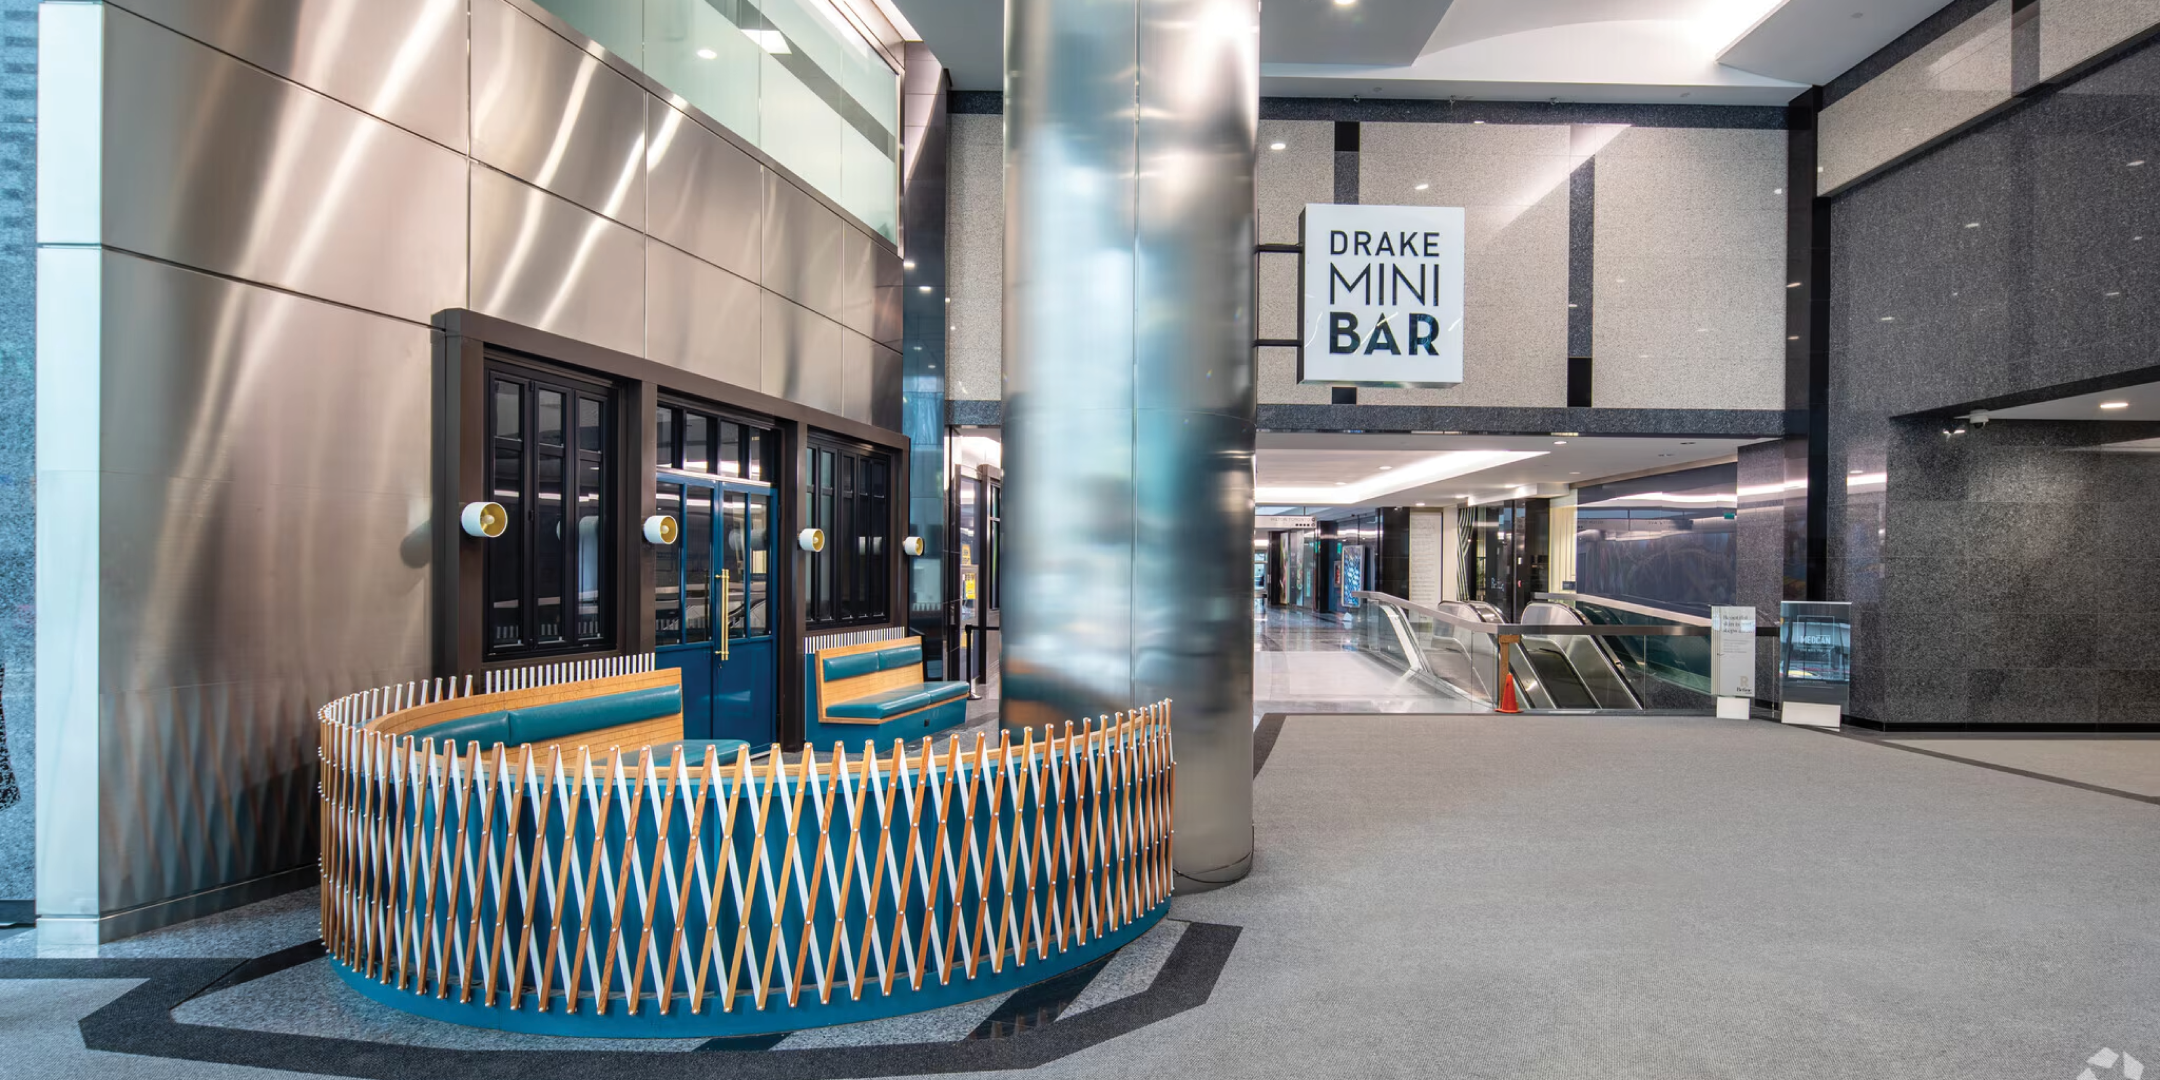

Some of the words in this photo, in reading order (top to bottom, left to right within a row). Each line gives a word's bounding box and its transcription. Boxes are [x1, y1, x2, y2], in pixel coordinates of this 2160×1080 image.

[1330, 230, 1440, 257] DRAKE
[1330, 262, 1439, 306] MINI
[1329, 312, 1440, 355] BAR
[1800, 635, 1831, 645] MEDCAN
[1740, 675, 1749, 687] R
